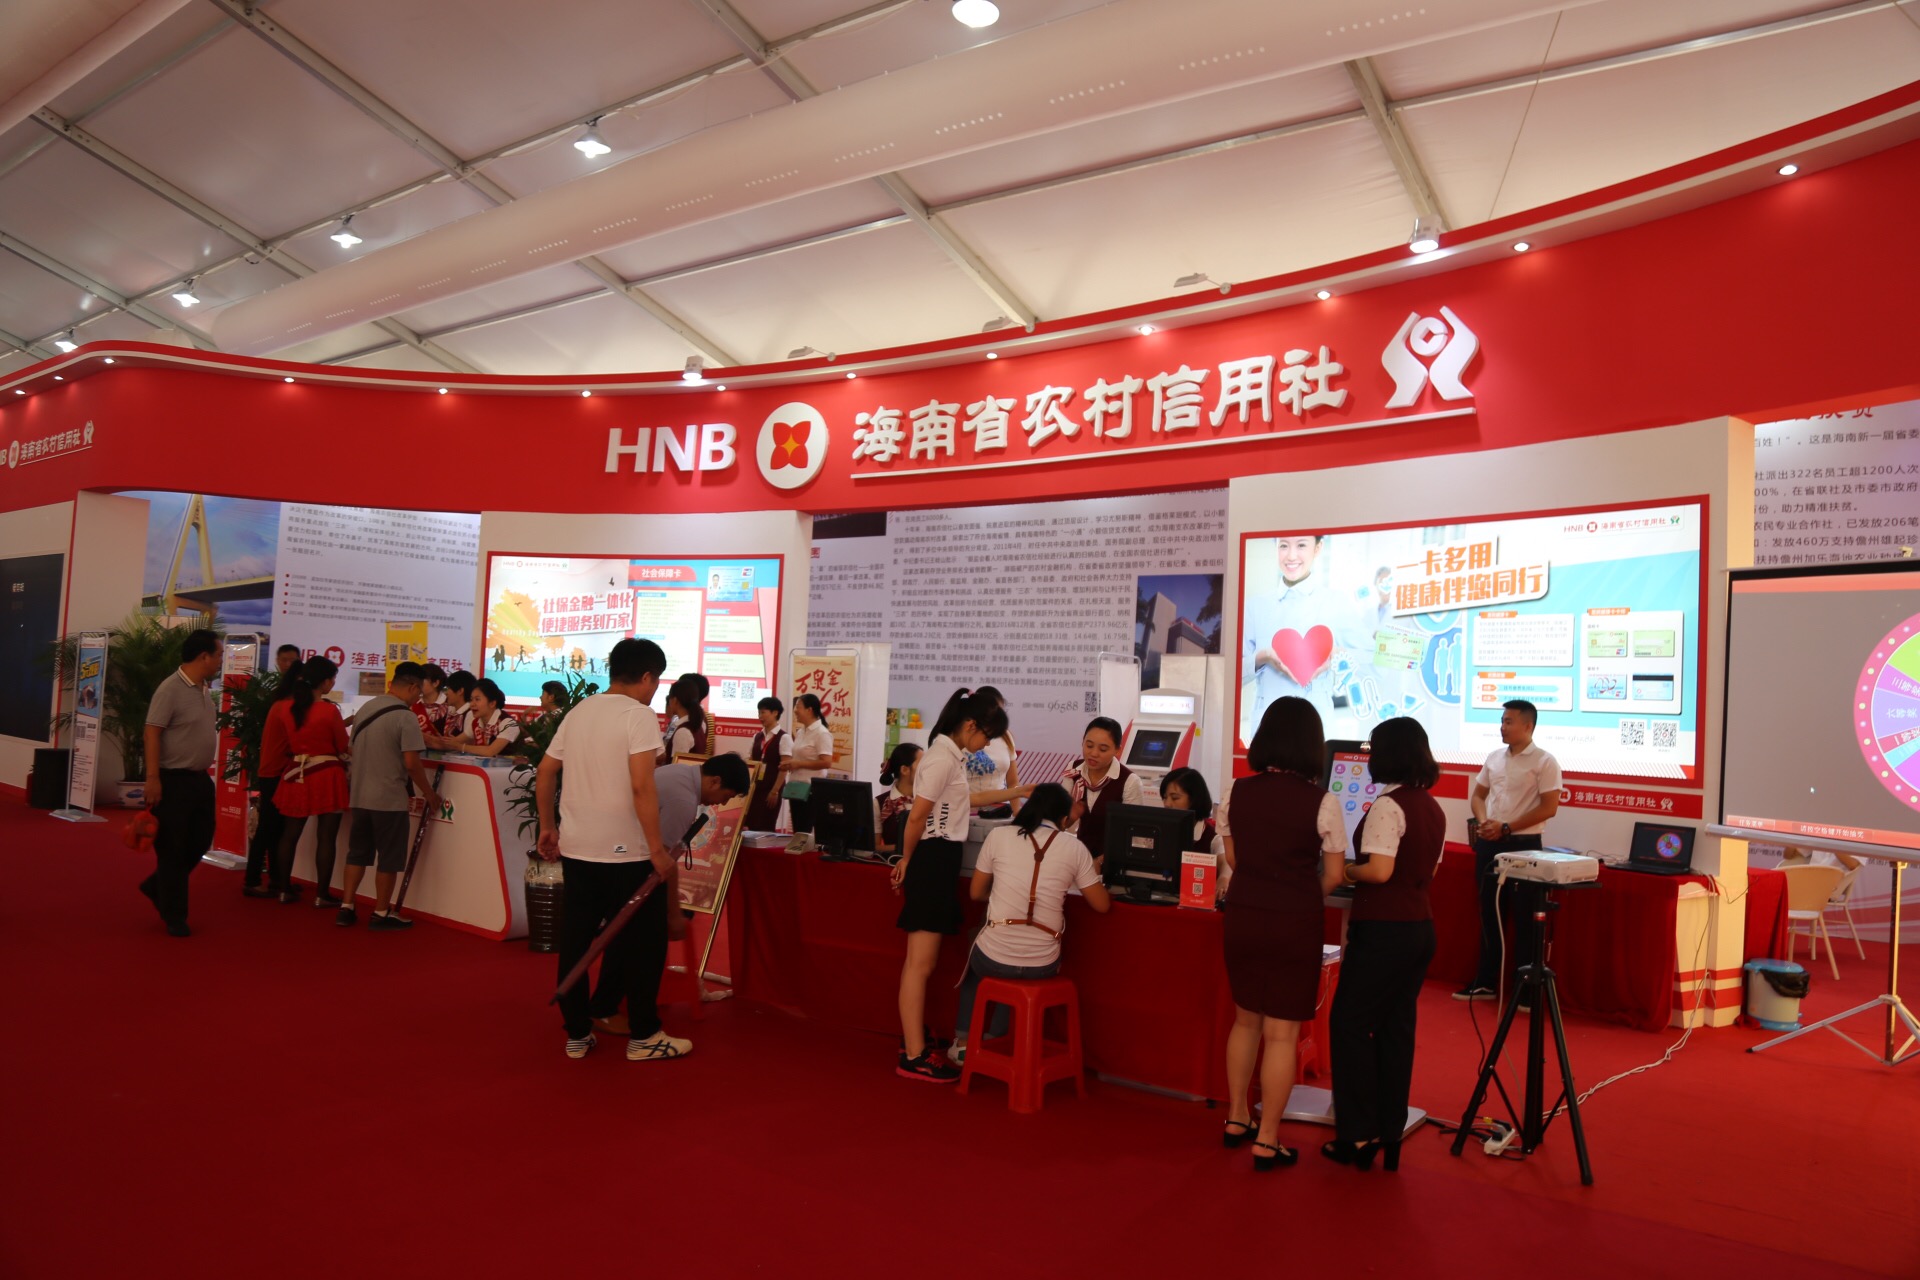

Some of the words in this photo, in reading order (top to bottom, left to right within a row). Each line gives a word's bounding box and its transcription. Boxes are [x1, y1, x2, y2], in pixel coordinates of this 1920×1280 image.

[604, 423, 737, 475] HNB
[851, 345, 1347, 463] 海南省农村信用社
[20, 428, 82, 460] 海南省农村信用社
[1563, 524, 1584, 533] HNB
[1600, 517, 1667, 530] 海南省农村信用社
[1396, 541, 1493, 576] 一卡多用
[642, 568, 682, 579] 社会保障卡
[1395, 564, 1544, 610] 健康伴您同行
[543, 592, 631, 614] 社保金融一体化
[541, 613, 631, 633] 便捷服务到万家
[1047, 700, 1079, 713] 96588
[1574, 790, 1657, 808] 海南省农村信用社
